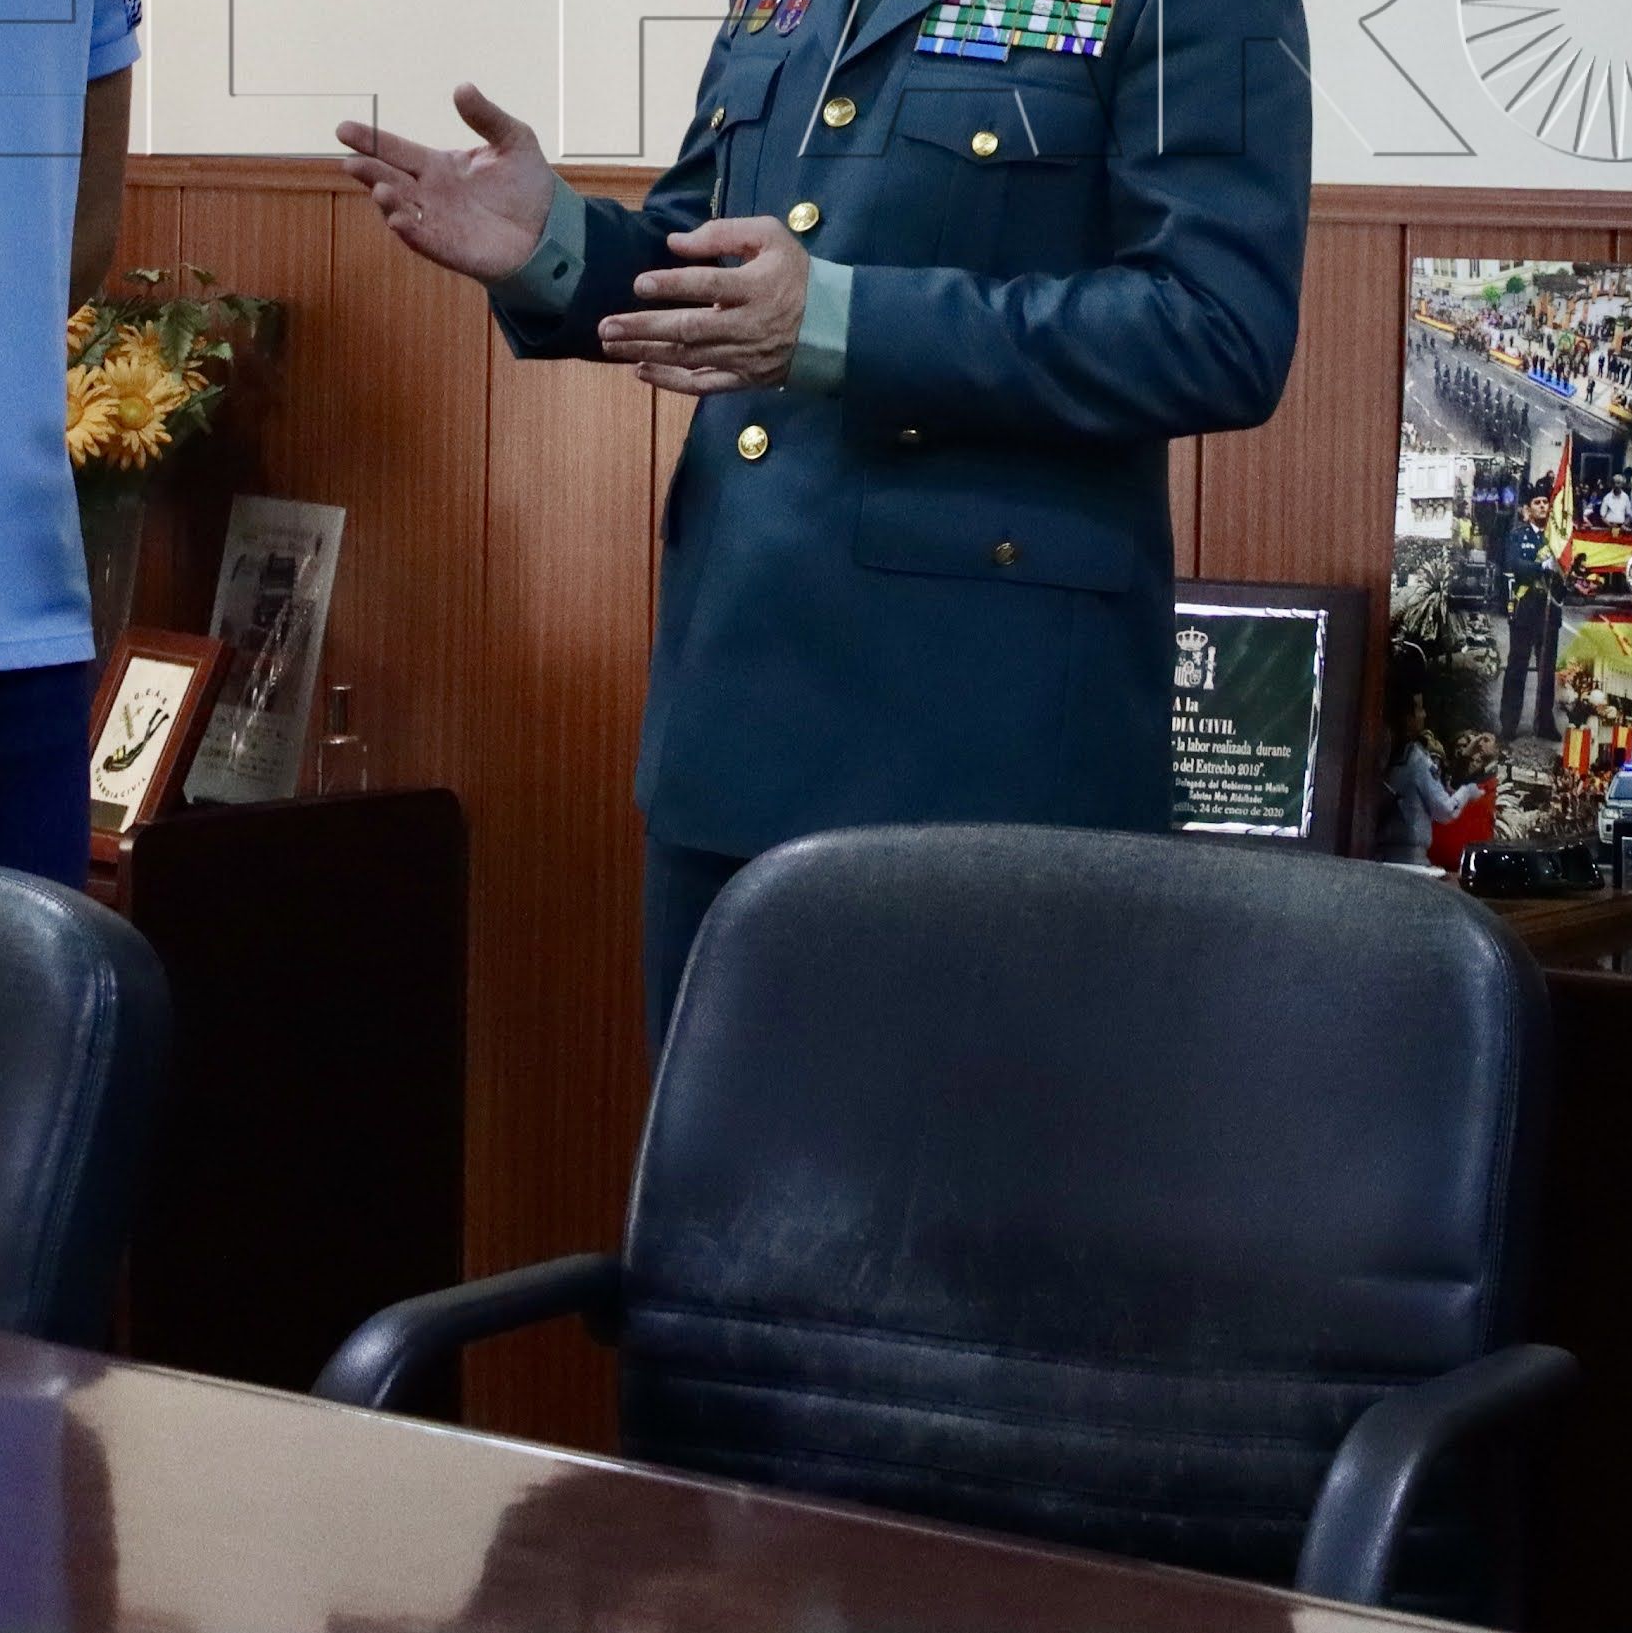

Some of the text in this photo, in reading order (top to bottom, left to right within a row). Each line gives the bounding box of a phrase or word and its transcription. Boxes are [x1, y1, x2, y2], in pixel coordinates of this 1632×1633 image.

[1172, 696, 1199, 712] A la
[1171, 716, 1237, 735] DIA CIVIL
[1176, 736, 1292, 757] la labor realizada durante
[1180, 757, 1194, 773] del
[1195, 758, 1236, 775] Estrecho
[1208, 779, 1219, 789] del
[1221, 780, 1252, 791] Gobierno
[1199, 803, 1210, 813] 24
[1211, 804, 1223, 814] de
[1224, 807, 1248, 815] enero
[1250, 806, 1261, 816] de
[1262, 807, 1284, 818] 2020
